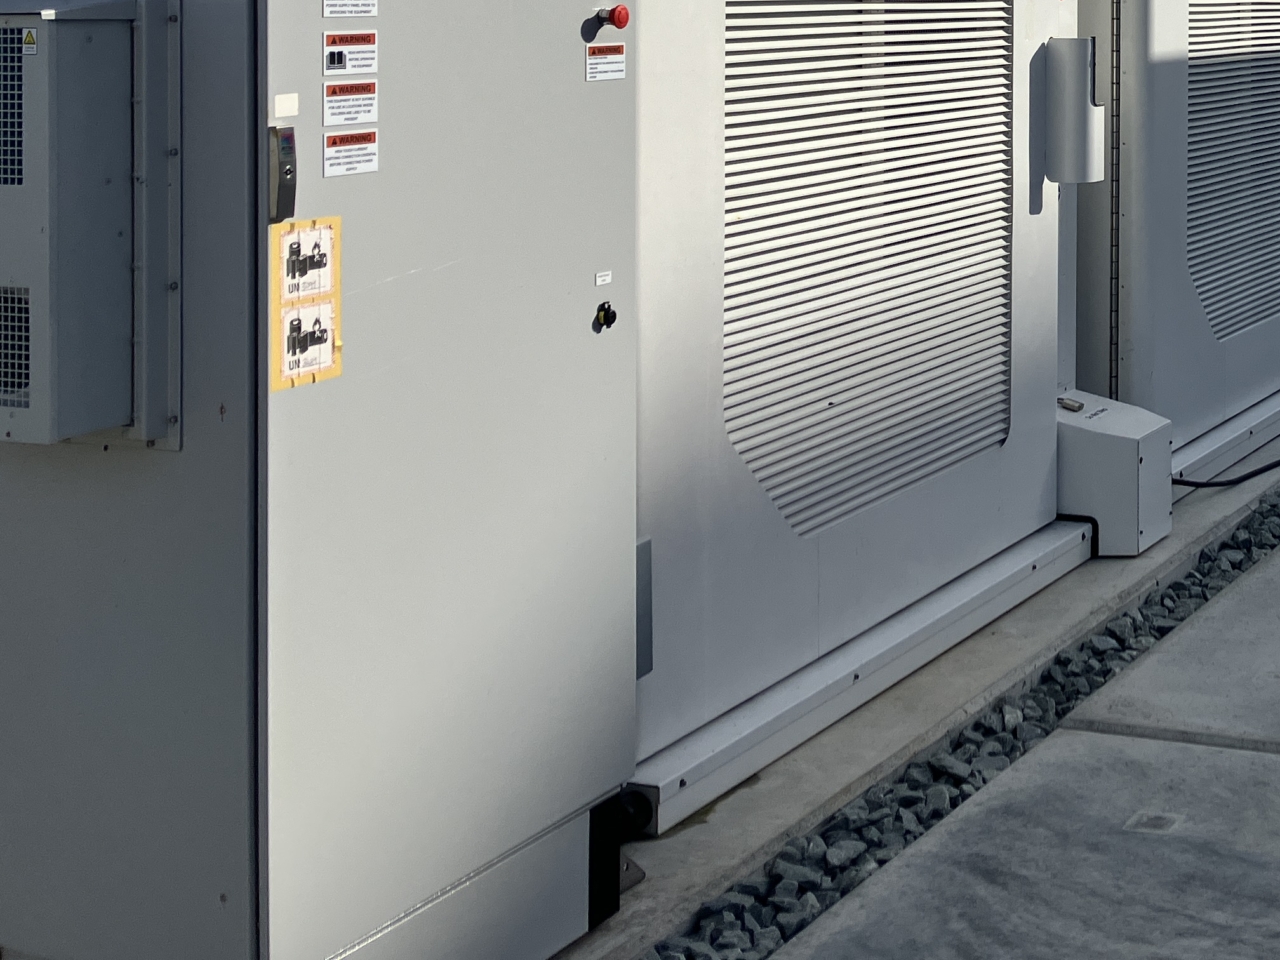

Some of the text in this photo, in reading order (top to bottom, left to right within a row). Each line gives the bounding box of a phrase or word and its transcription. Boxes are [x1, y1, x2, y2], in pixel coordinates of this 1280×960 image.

[338, 35, 372, 44] WARNING
[597, 46, 622, 54] WARNING
[338, 84, 372, 94] WARNING
[338, 134, 372, 144] WARNING
[288, 282, 299, 294] UN
[288, 357, 300, 371] UN
